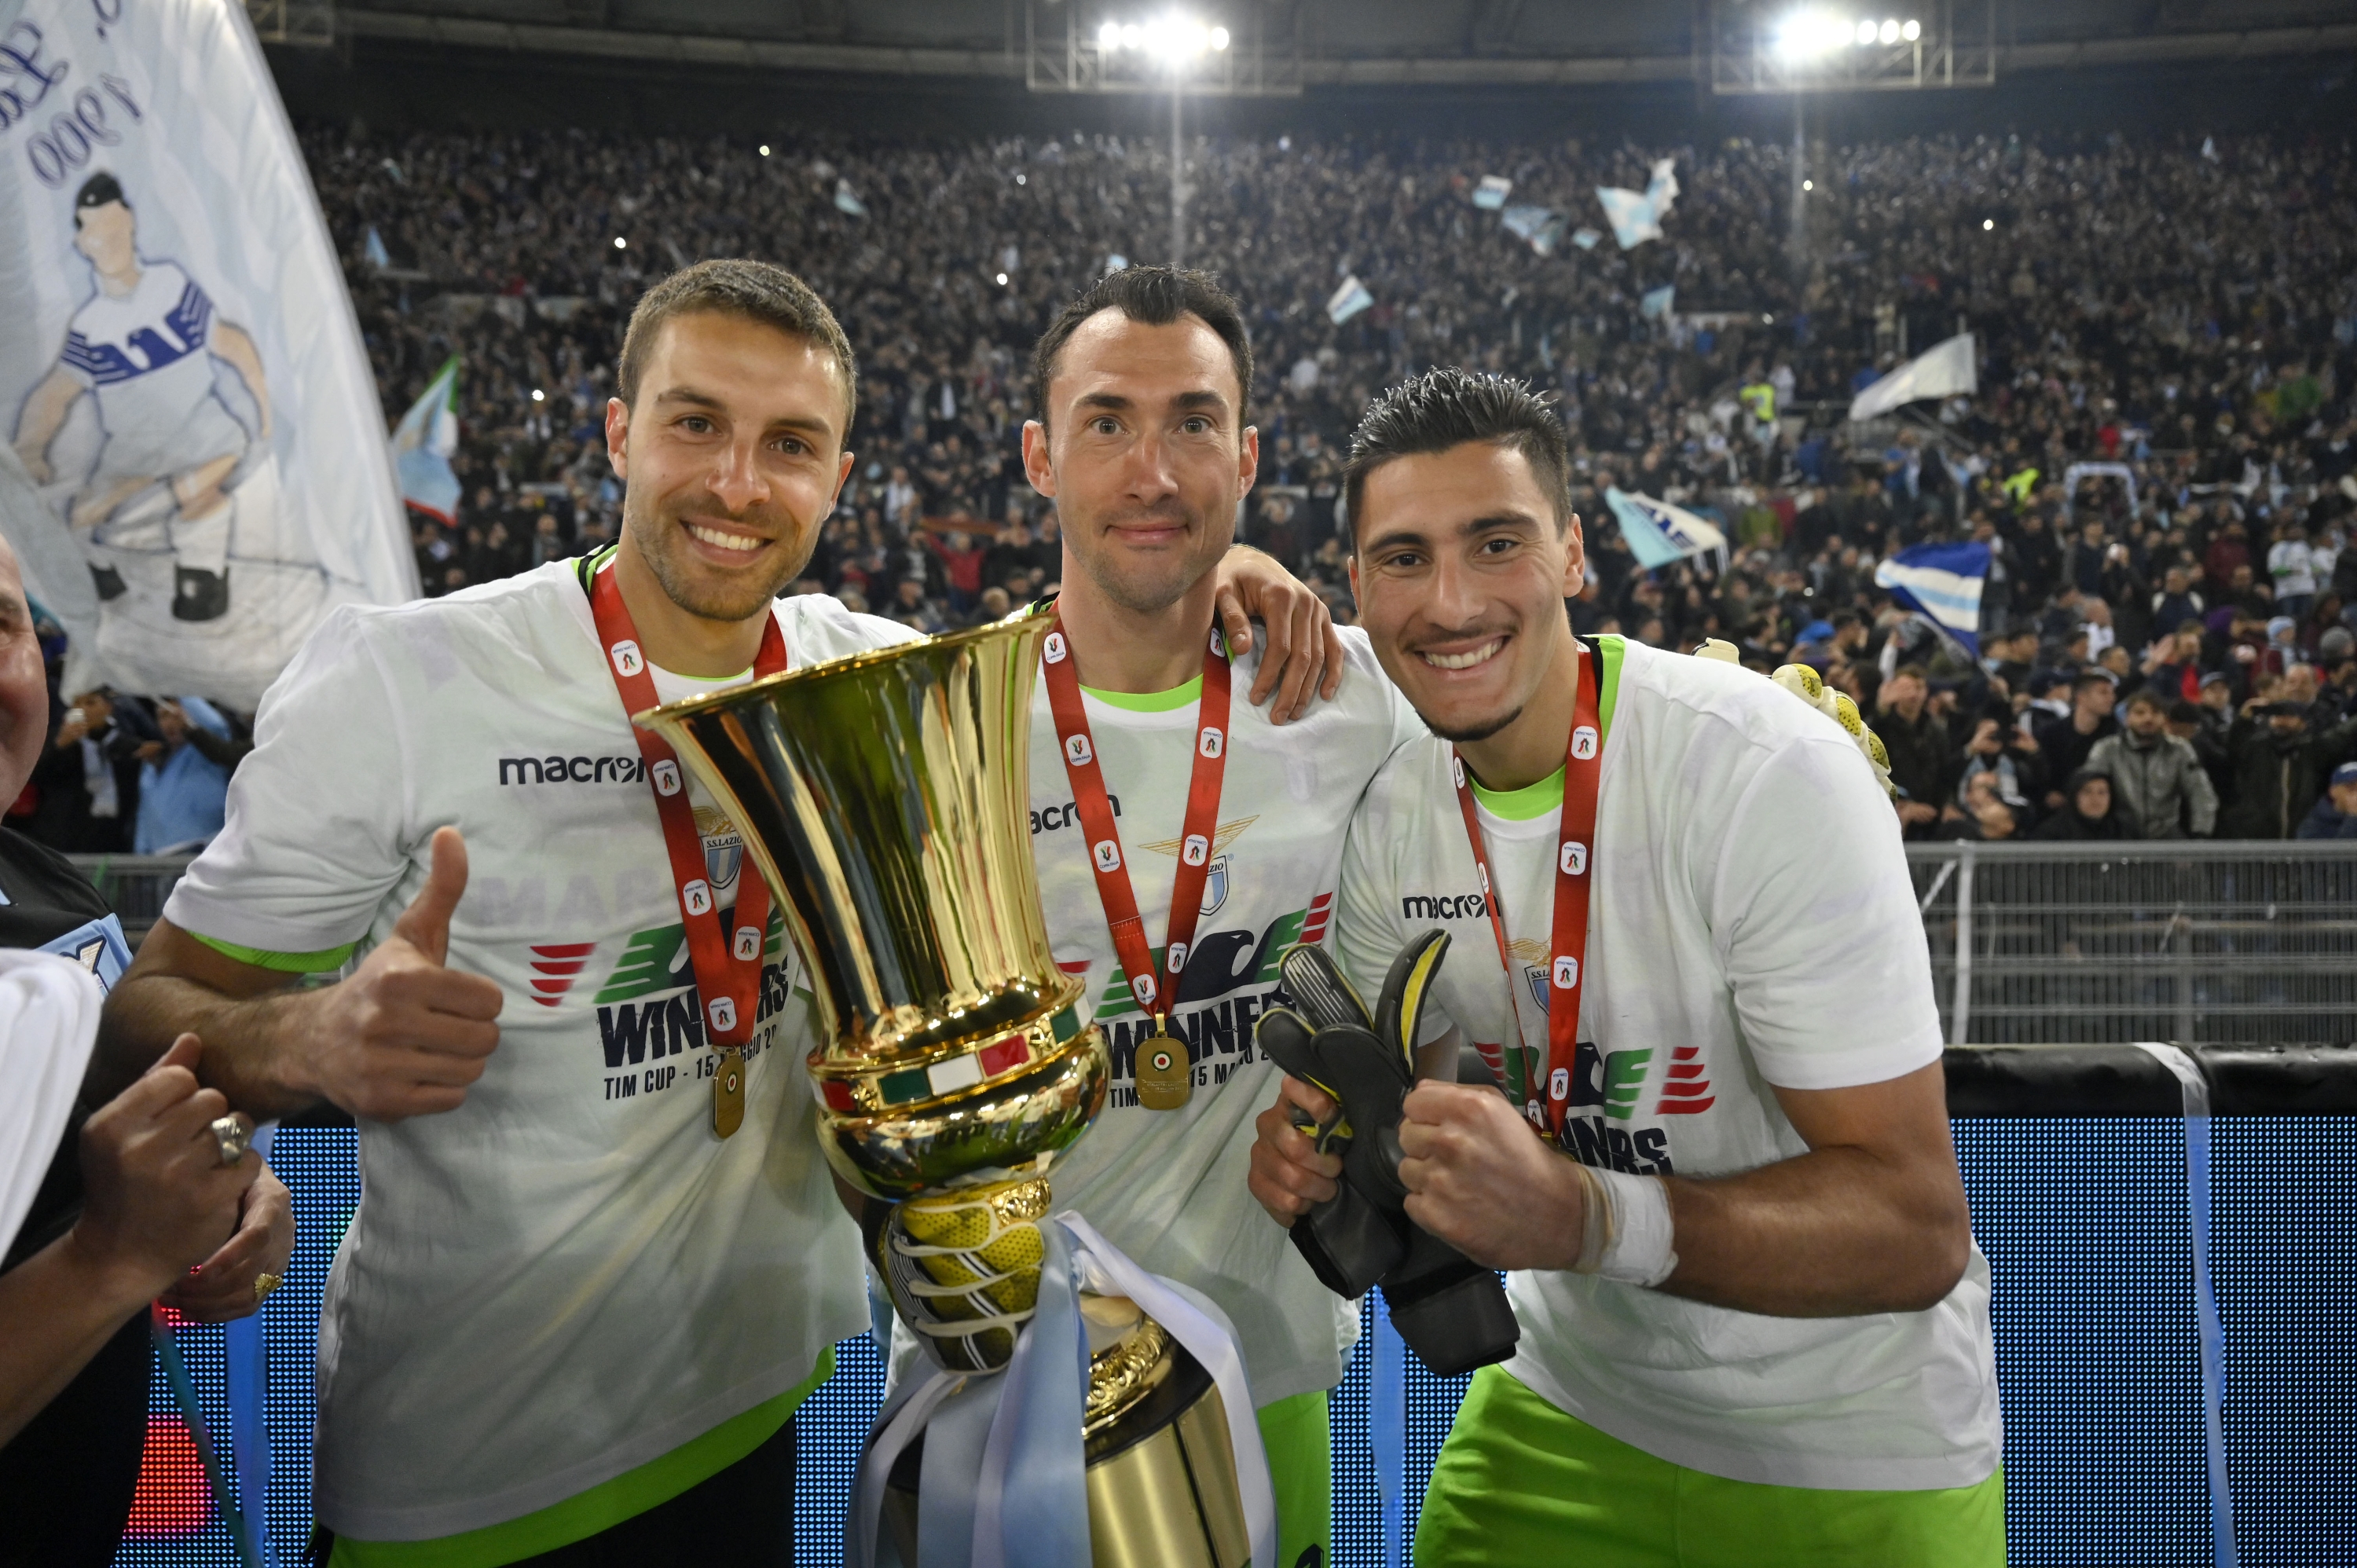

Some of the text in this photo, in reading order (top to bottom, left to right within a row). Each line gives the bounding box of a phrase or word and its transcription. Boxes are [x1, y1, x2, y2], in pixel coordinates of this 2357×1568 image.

[597, 953, 789, 1068] WINRS
[604, 1075, 637, 1100] TIM
[644, 1066, 676, 1094] CUP
[696, 1055, 714, 1079] 15
[1110, 1087, 1138, 1108] TIM
